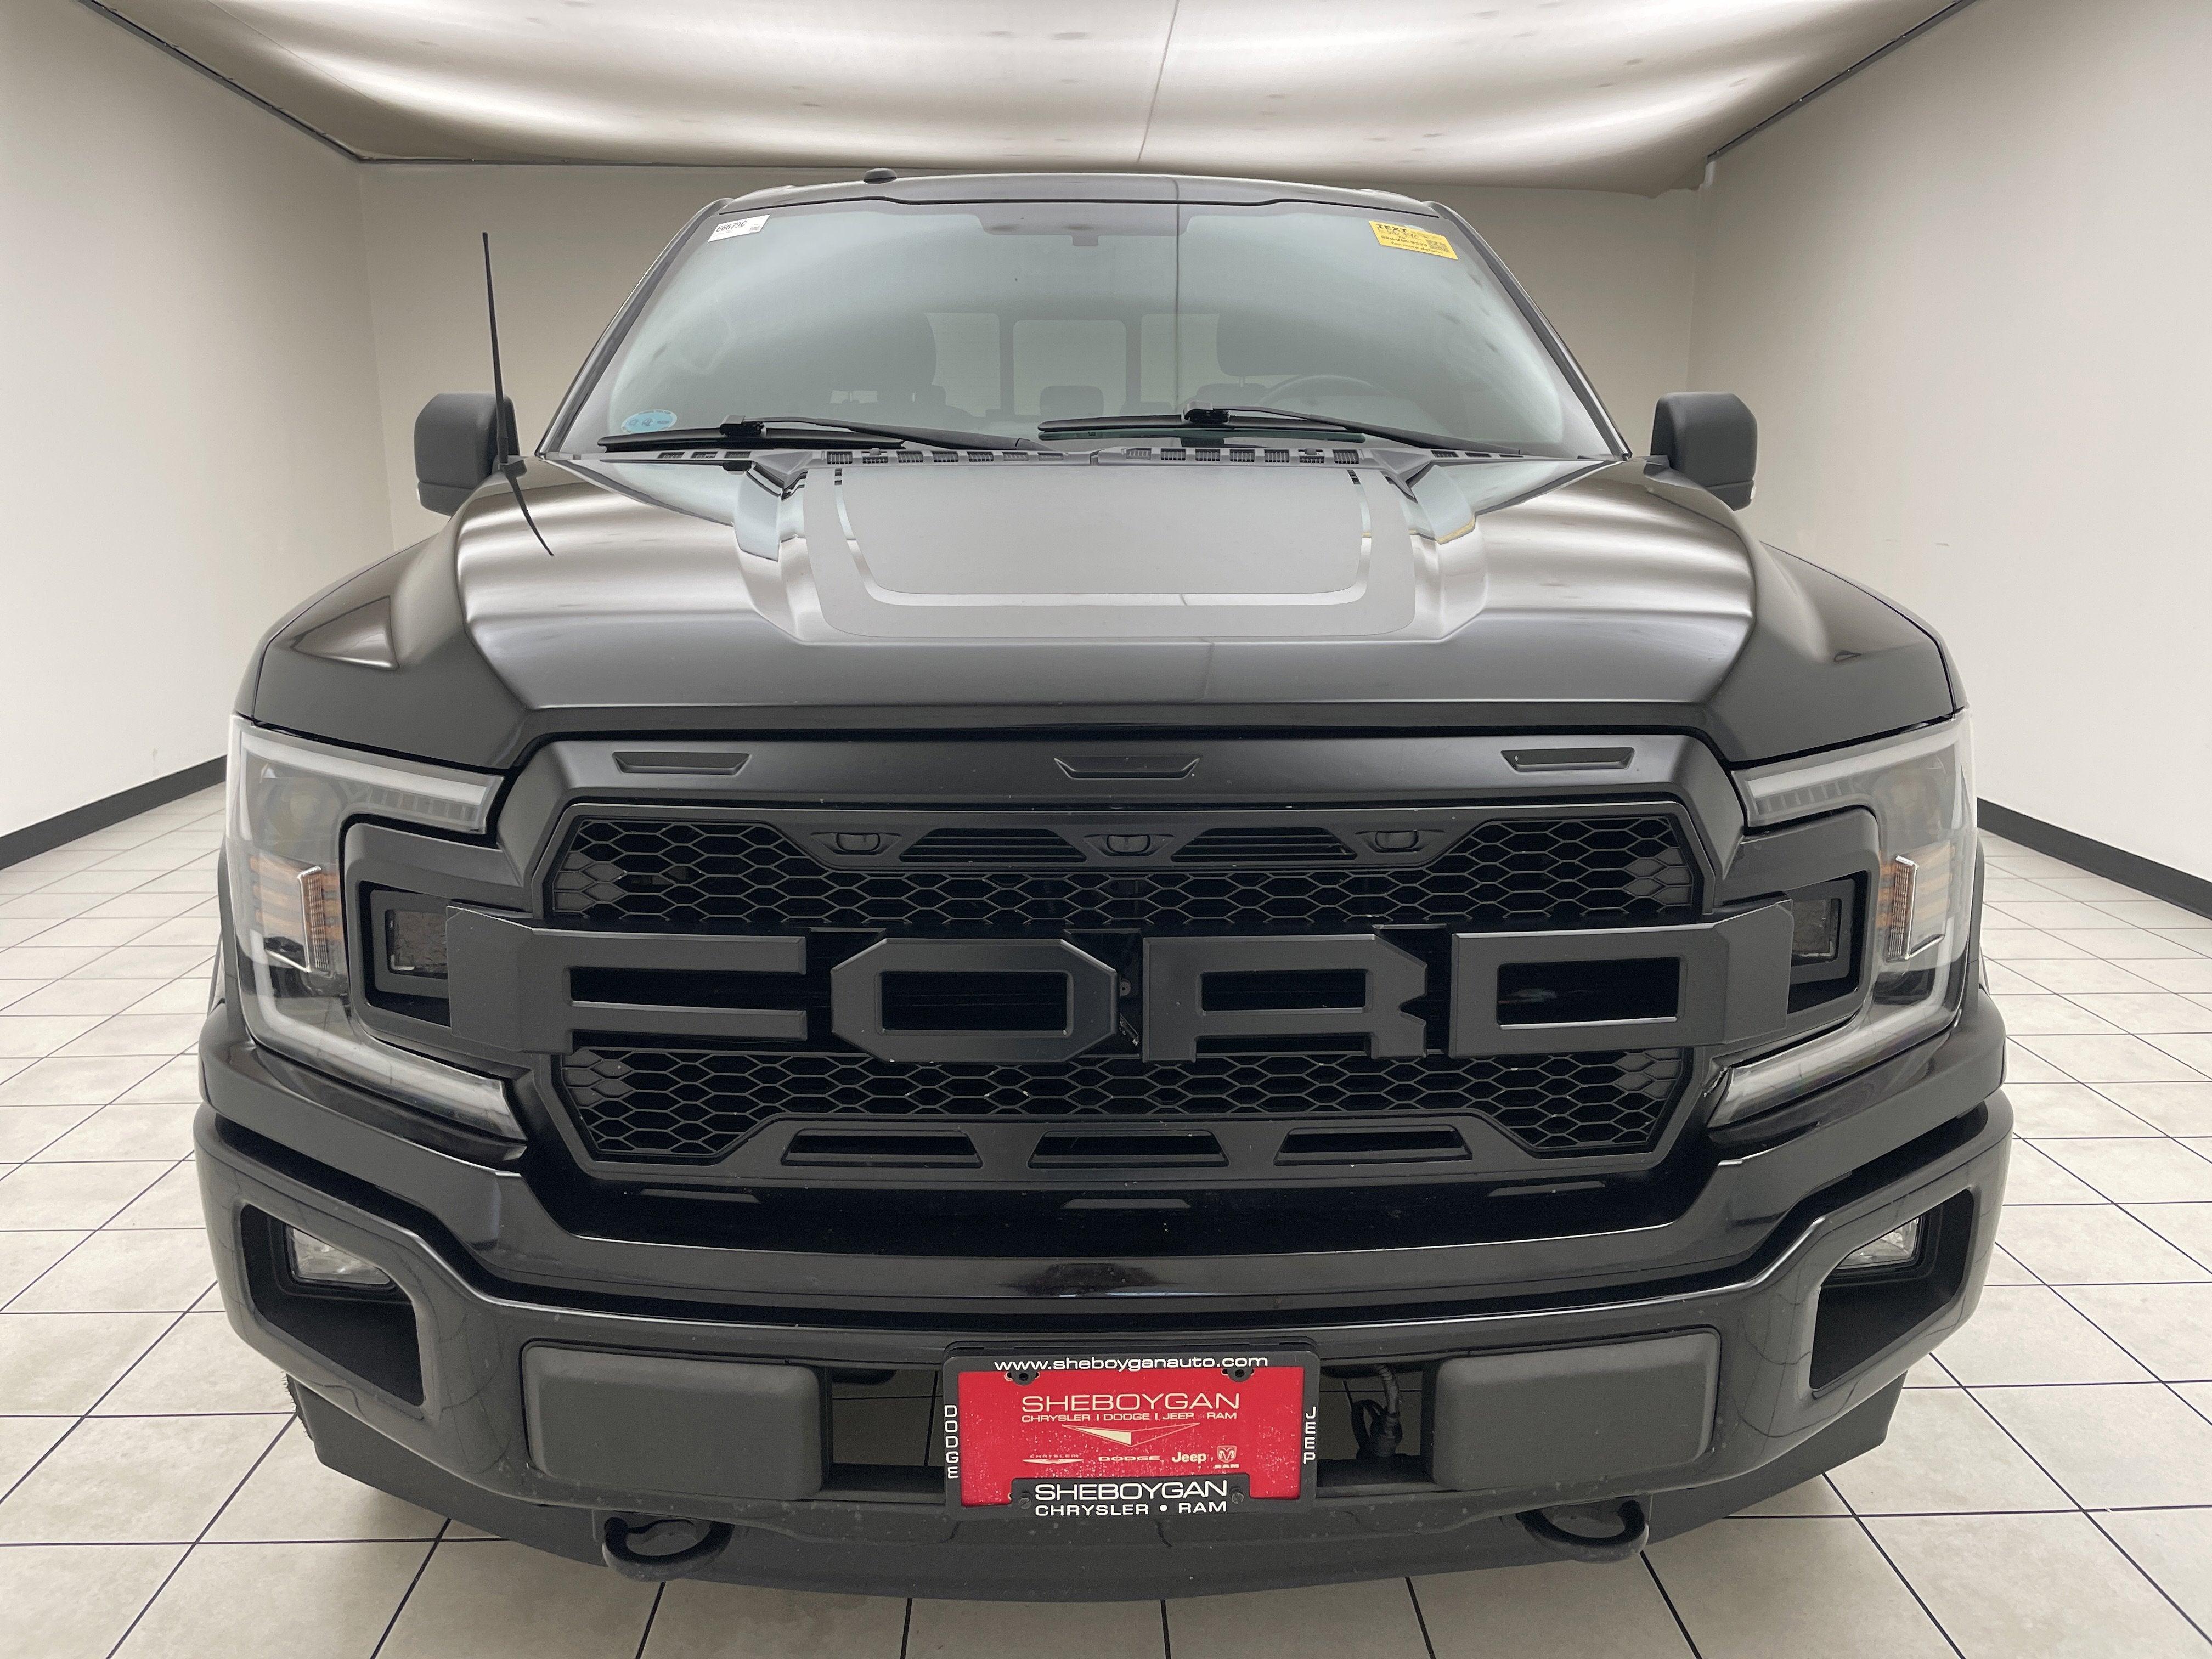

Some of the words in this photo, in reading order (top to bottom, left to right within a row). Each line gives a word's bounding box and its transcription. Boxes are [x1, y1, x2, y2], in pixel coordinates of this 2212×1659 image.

[1375, 223, 1407, 233] TEXT
[447, 900, 1793, 1063] FORD
[994, 1357, 1268, 1372] www.sheboyganauto.com
[1022, 1393, 1239, 1413] SHEBOYGAN
[1021, 1414, 1091, 1423] CHRYSLER
[1103, 1413, 1150, 1421] DODGE
[944, 1404, 959, 1479] DODGE
[1304, 1406, 1317, 1464] JEEP
[1171, 1451, 1207, 1464] Jeep
[1035, 1480, 1228, 1501] SHEBOYGAN
[1035, 1503, 1149, 1516] CHRYSLER
[1178, 1500, 1227, 1513] RAM
